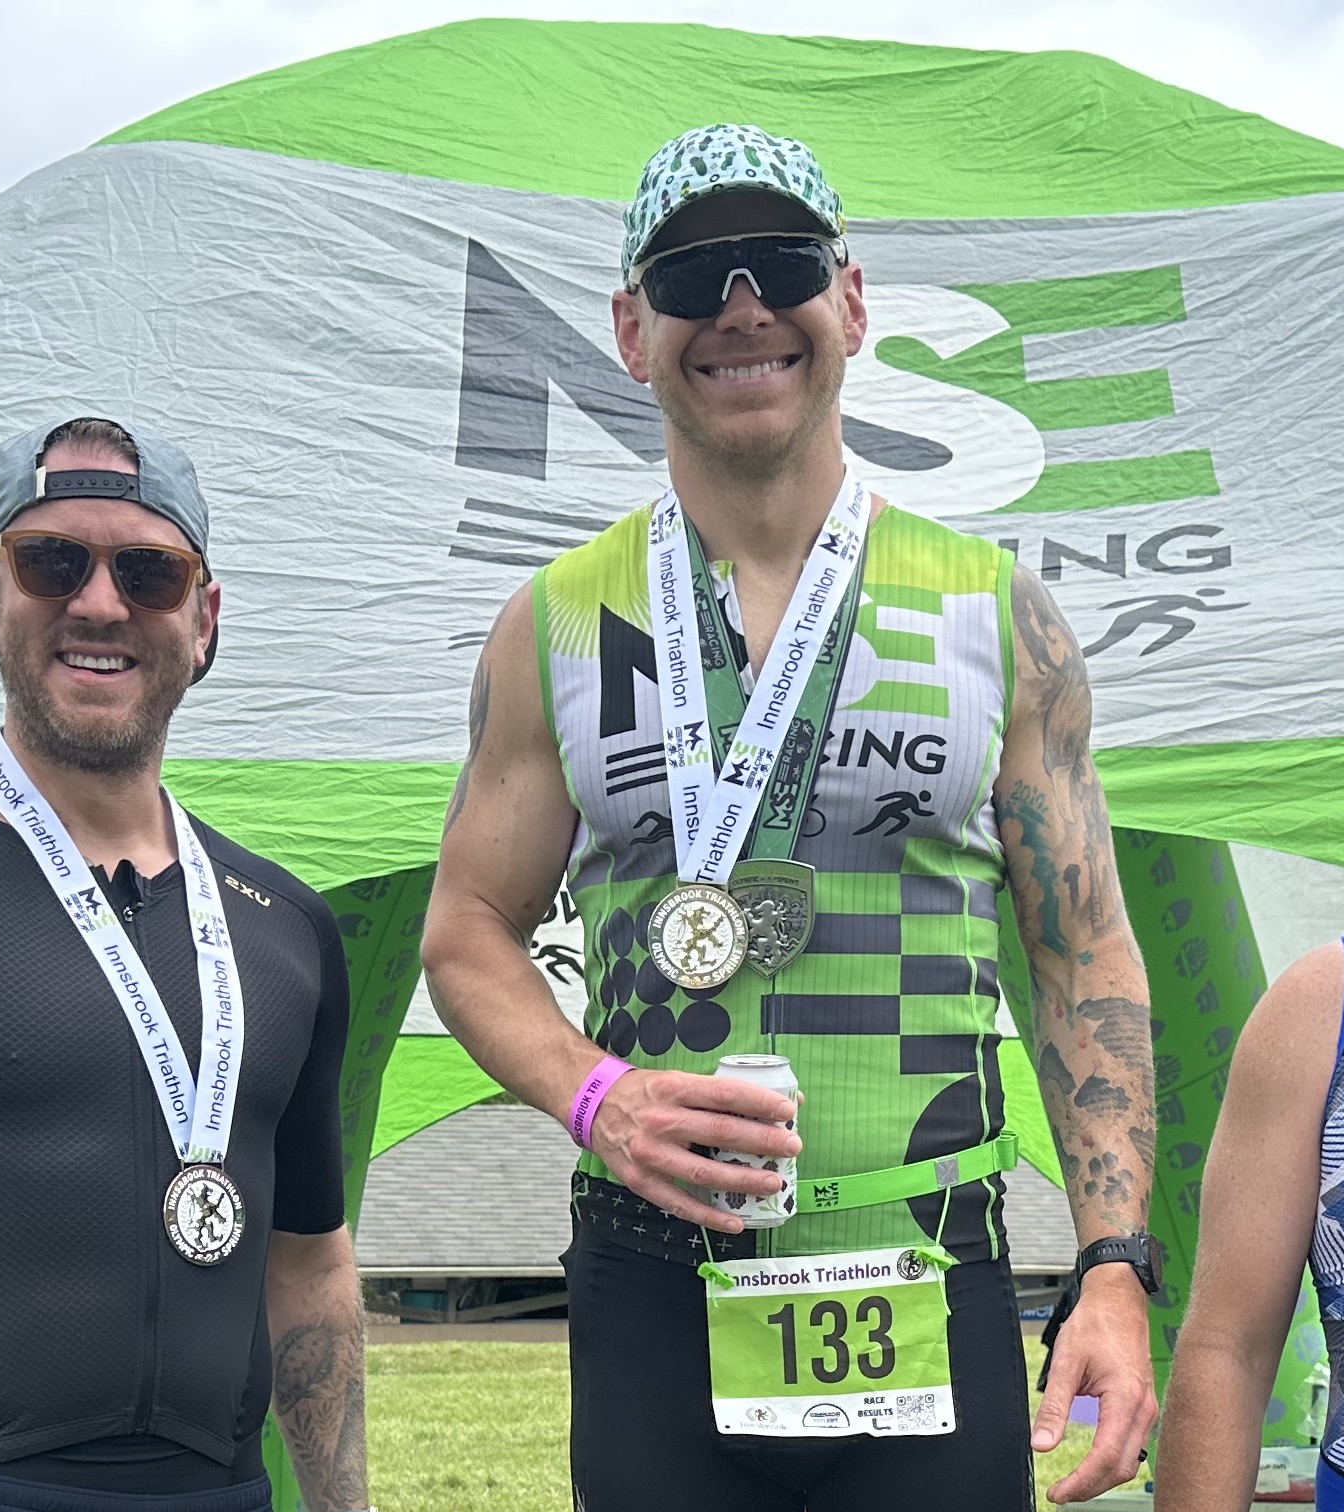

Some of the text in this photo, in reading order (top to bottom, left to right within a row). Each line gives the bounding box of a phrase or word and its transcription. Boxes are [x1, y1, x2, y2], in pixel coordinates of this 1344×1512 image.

[660, 547, 688, 709] Innsbrook Triathlon
[704, 626, 725, 668] RACING
[756, 566, 839, 730] Innsbrook Triathlon
[781, 717, 802, 765] RACING
[20, 805, 71, 878] Triathlon
[695, 803, 743, 883] Triathlon
[225, 875, 271, 907] 2XU
[652, 890, 746, 939] INNSBROOK TRIATHLON
[651, 942, 743, 983] OLYMPIC SPRINT
[104, 944, 190, 1124] Innsbrook Triathlon
[205, 960, 233, 1130] Innsbrook Triathlon
[167, 1169, 243, 1211] INNSBROOK TRIATHLON
[727, 1262, 891, 1287] nnsbrook Triathlon
[767, 1295, 896, 1385] 133
[857, 1408, 894, 1418] RESULTS
[863, 1396, 886, 1405] RACE
